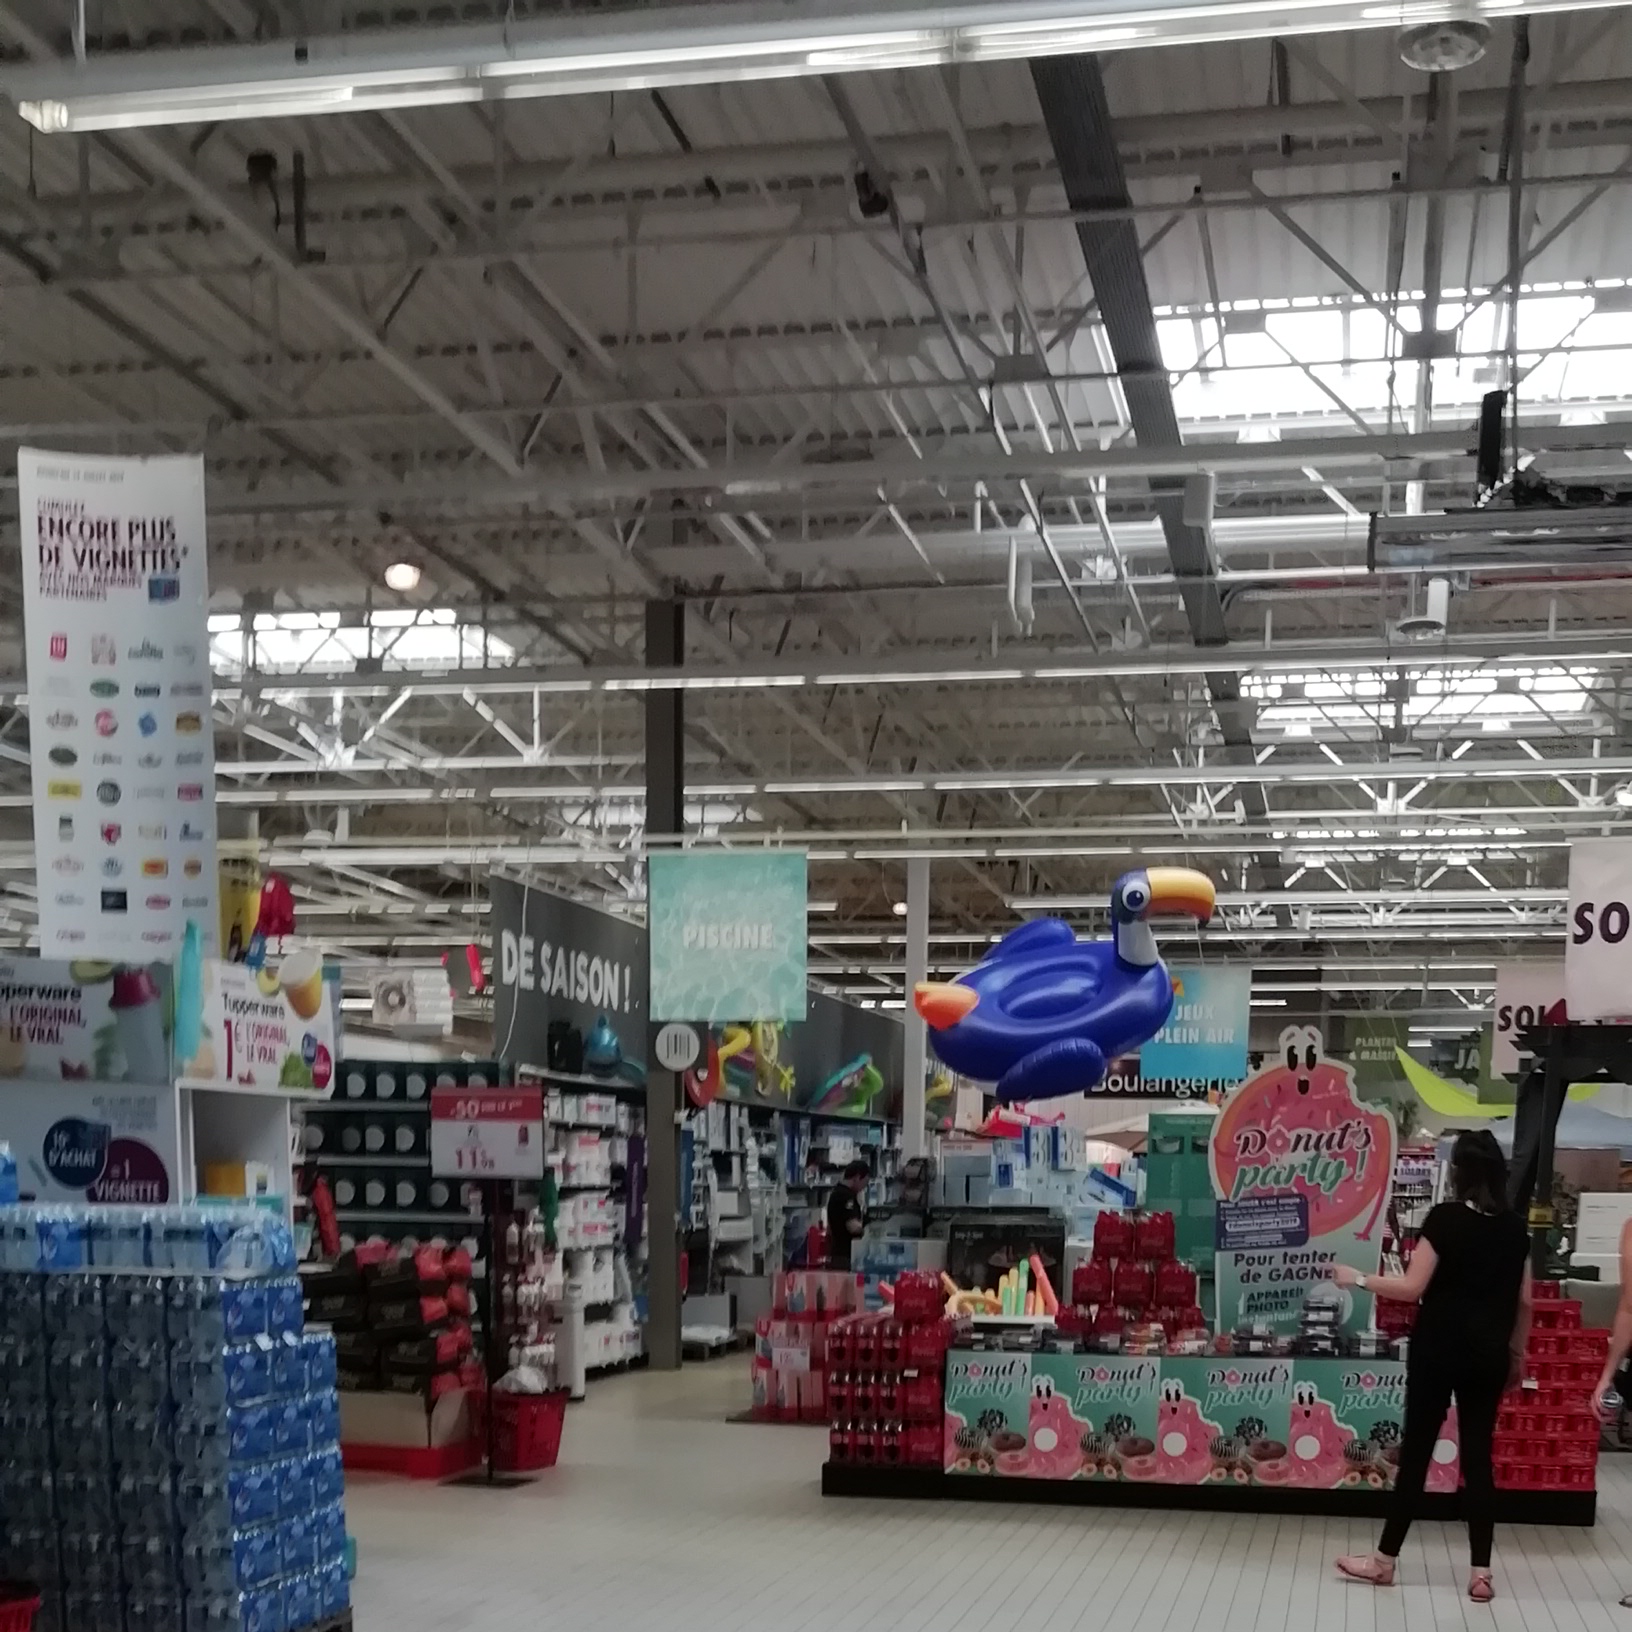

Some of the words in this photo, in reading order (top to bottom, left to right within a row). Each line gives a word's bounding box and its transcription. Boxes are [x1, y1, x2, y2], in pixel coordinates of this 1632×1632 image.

[37, 515, 118, 543] ENCORE
[128, 518, 176, 544] PLUS
[39, 545, 63, 570] DE
[683, 922, 774, 950] PISCINE
[502, 928, 534, 990] DE
[541, 941, 619, 1011] SAISON
[222, 992, 285, 1019] Tupperware
[1175, 1004, 1214, 1022] JEUX
[1154, 1027, 1199, 1043] PLEIN
[1206, 1027, 1235, 1043] AIR
[1236, 1120, 1371, 1156] Donut's
[95, 1180, 160, 1202] VIGNETTE
[1234, 1253, 1275, 1267] Pour
[1283, 1250, 1337, 1264] tenter
[1240, 1269, 1262, 1283] de
[1269, 1266, 1336, 1281] GAGNE
[1247, 1300, 1289, 1314] PHOTO
